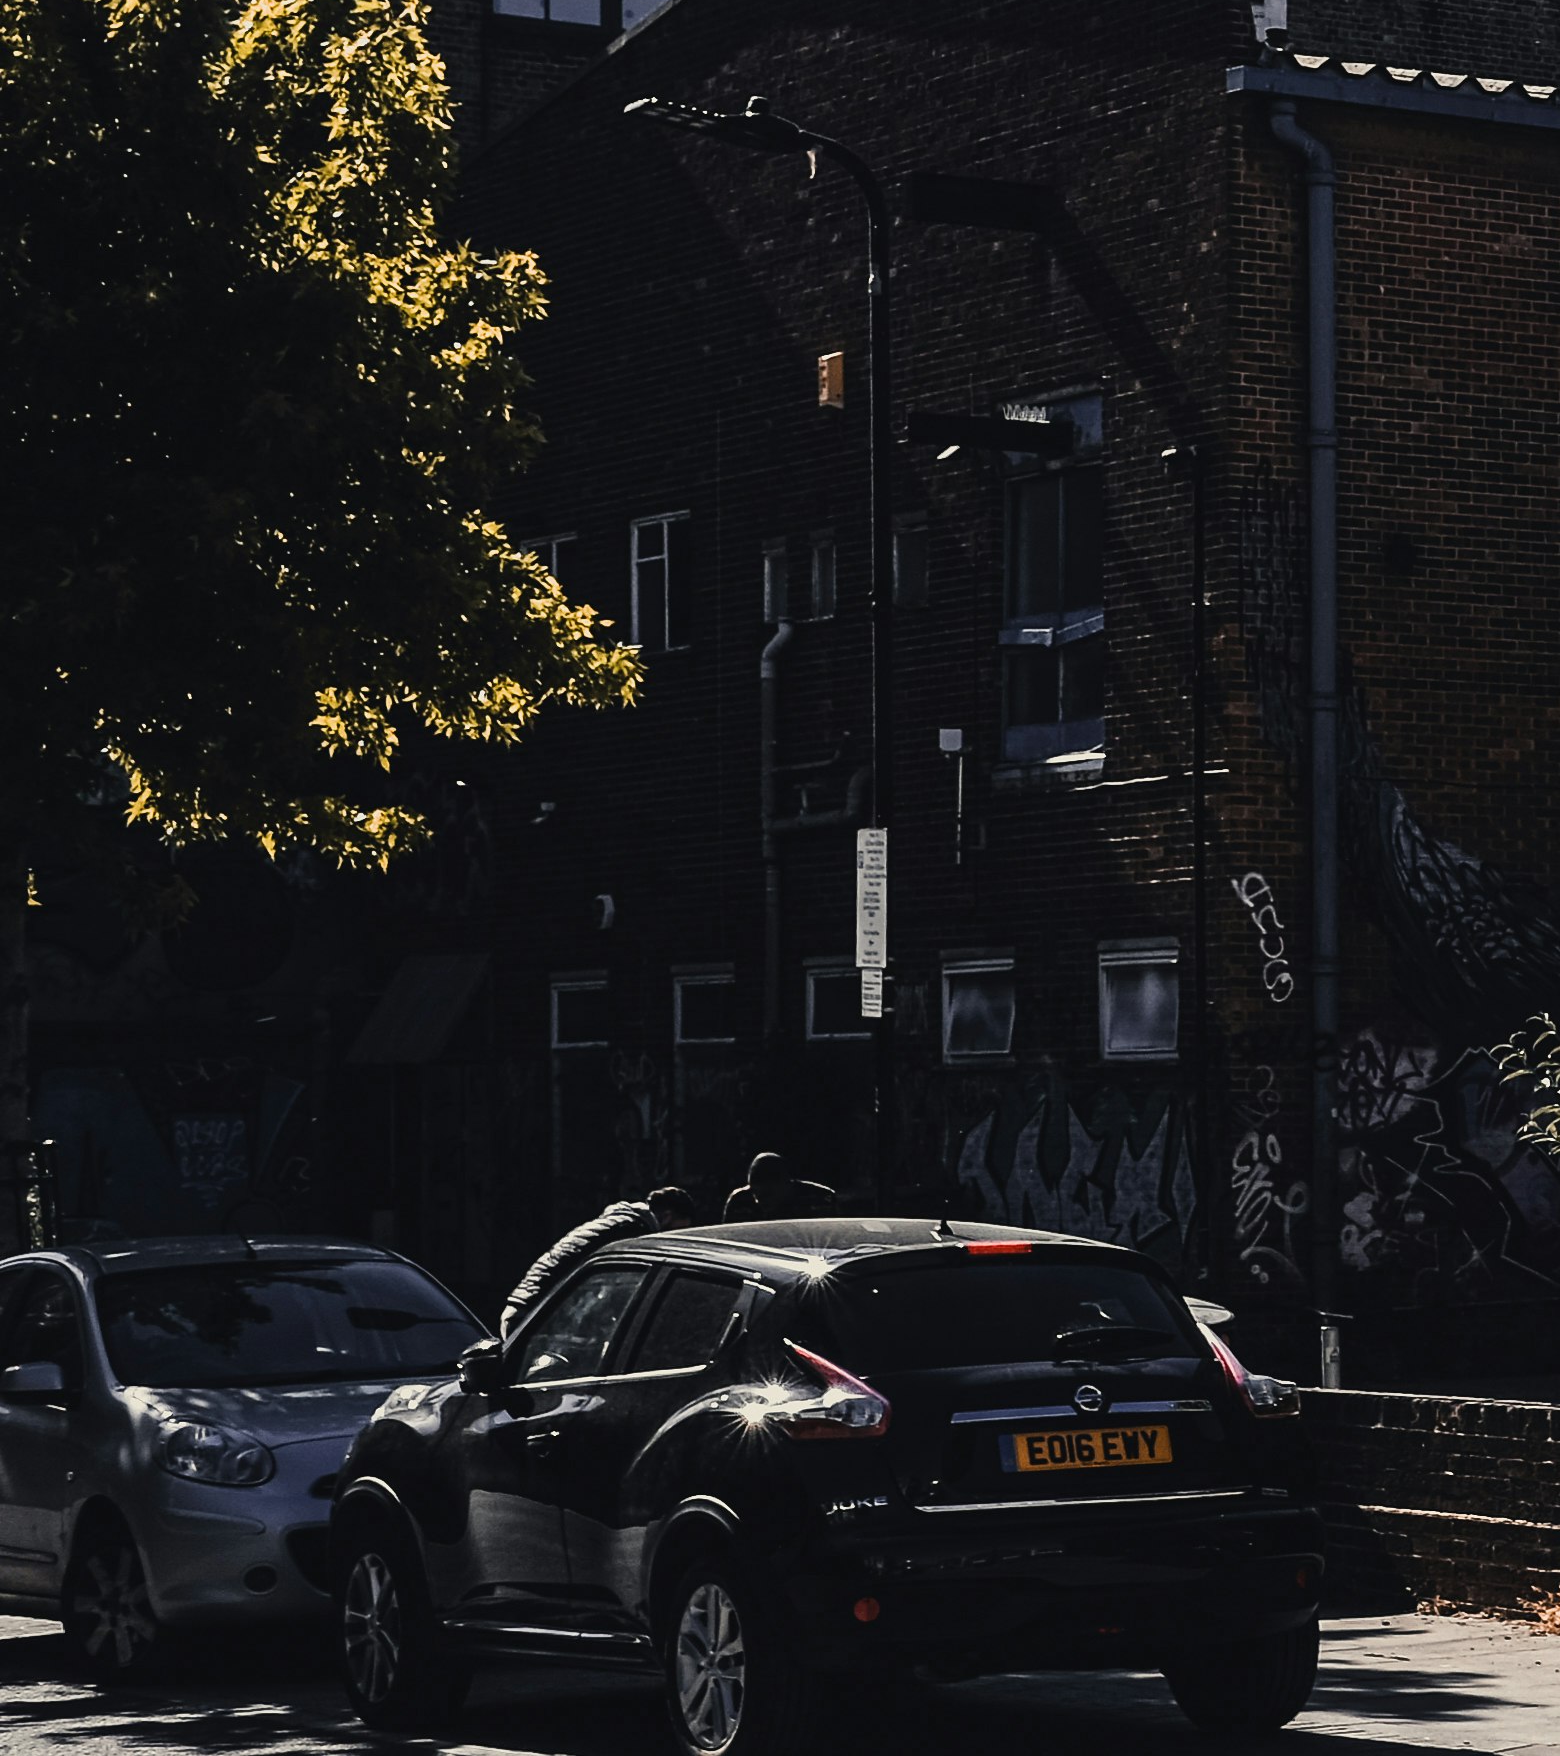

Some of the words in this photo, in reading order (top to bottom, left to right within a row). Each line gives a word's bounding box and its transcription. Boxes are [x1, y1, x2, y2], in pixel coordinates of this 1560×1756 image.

[1027, 1434, 1095, 1466] EO16
[1102, 1430, 1157, 1460] EWY
[826, 1495, 889, 1515] JUKE
